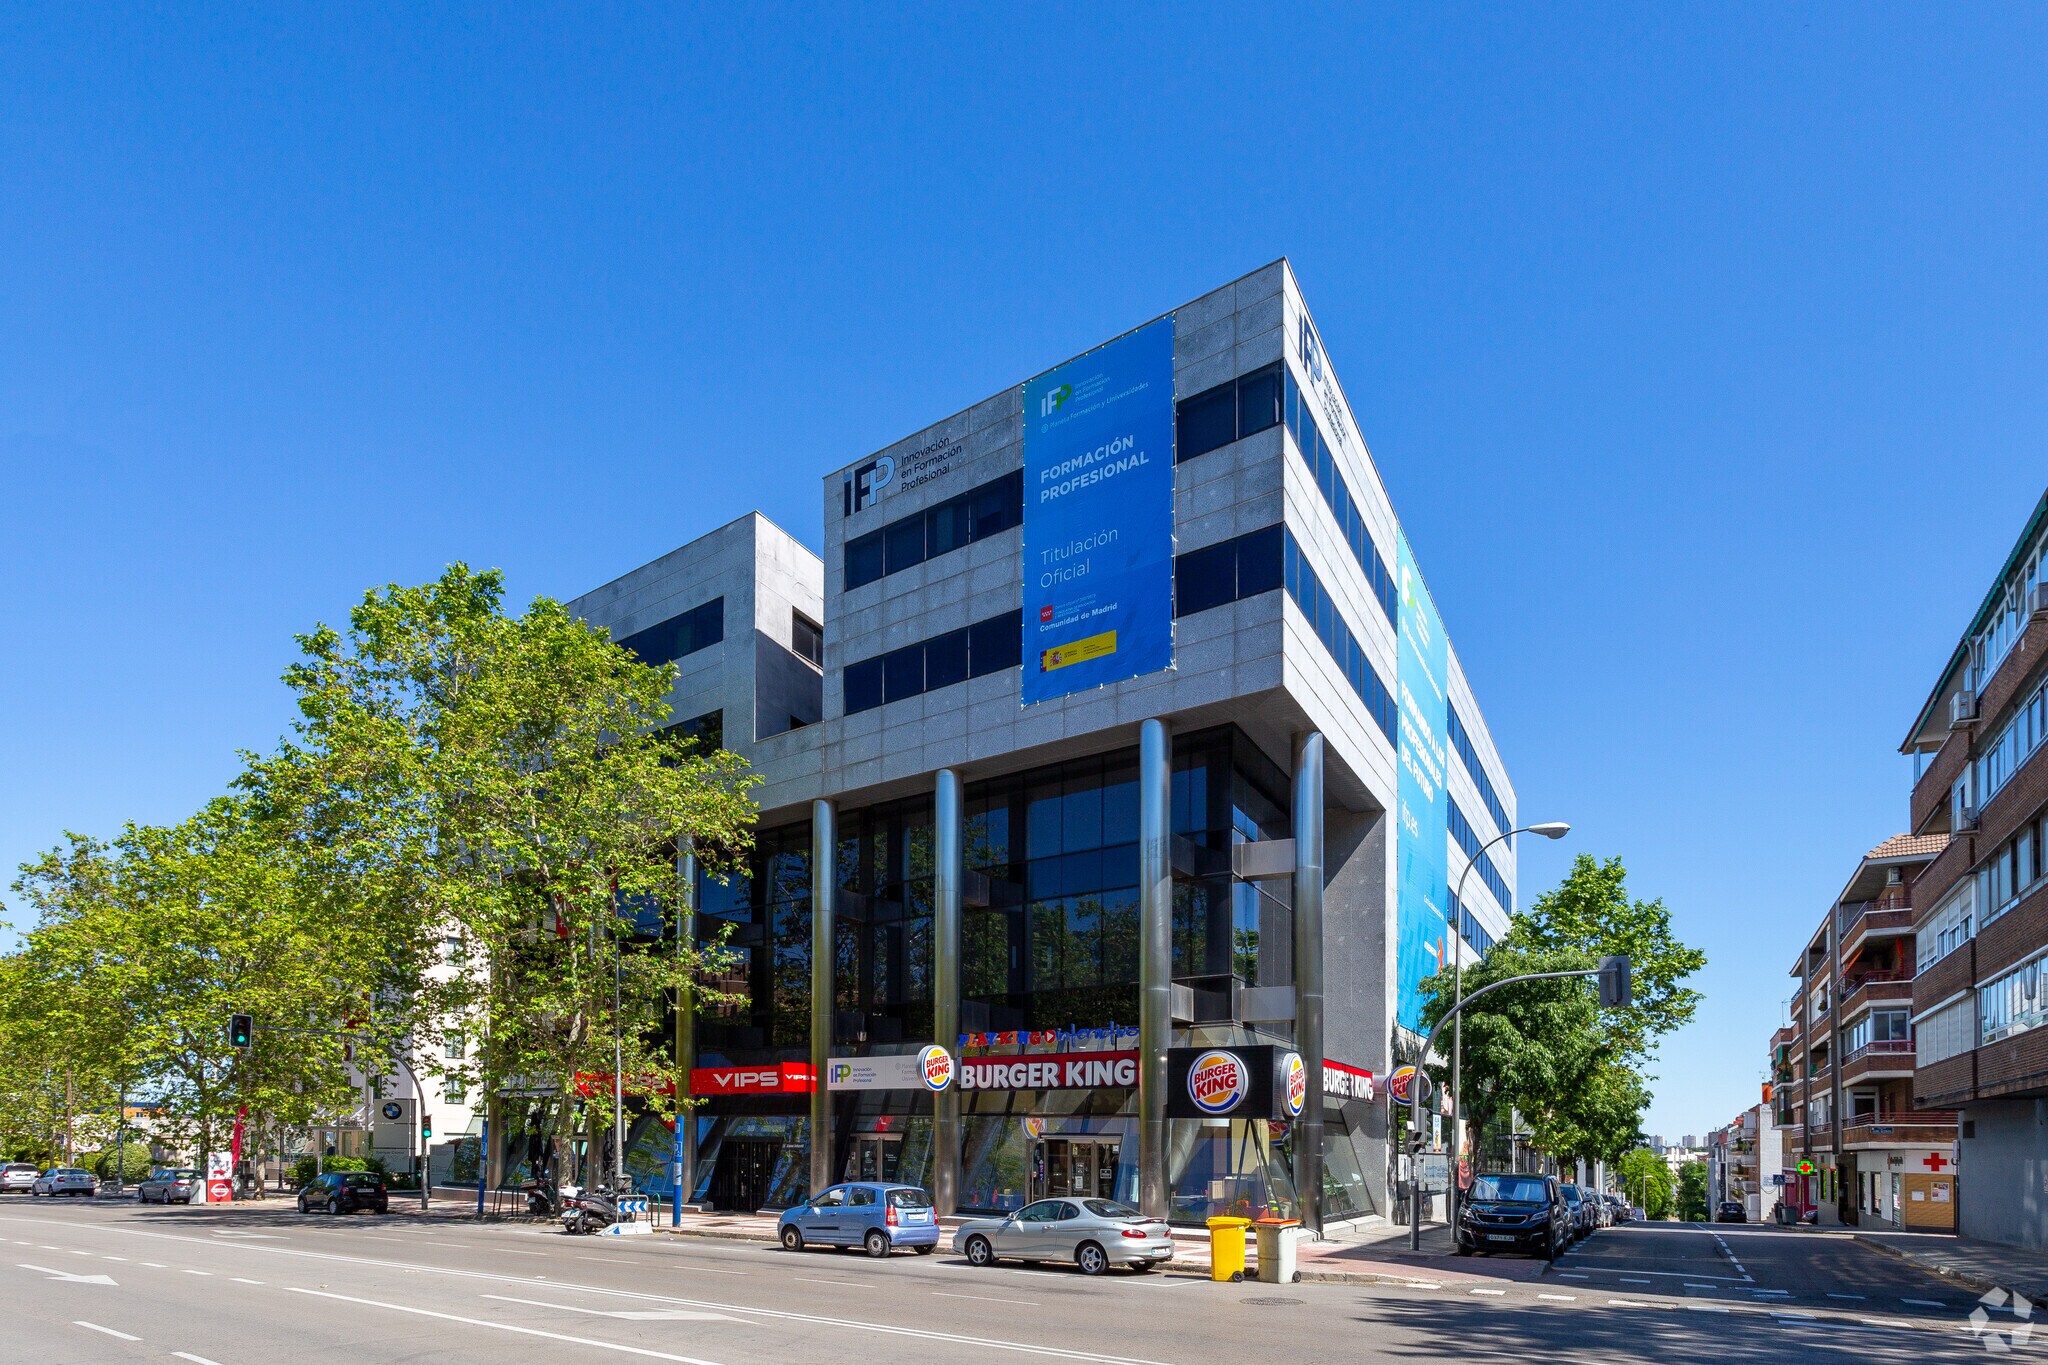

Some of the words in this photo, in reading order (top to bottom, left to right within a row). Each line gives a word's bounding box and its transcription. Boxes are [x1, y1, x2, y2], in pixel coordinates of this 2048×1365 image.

[1070, 402, 1101, 419] Formación
[1107, 381, 1149, 404] Universidades
[901, 437, 950, 465] Innovación
[901, 468, 912, 479] en
[914, 444, 962, 473] Formación
[1040, 434, 1134, 484] FORMACIÓN
[901, 463, 950, 492] Profesional
[1040, 451, 1150, 503] PROFESIONAL
[1040, 528, 1119, 565] Titulación
[1040, 558, 1090, 588] Oficial
[1040, 615, 1079, 632] Comunidad
[1080, 612, 1090, 620] de
[1091, 602, 1118, 616] Madrid
[925, 1055, 949, 1069] BURGER
[926, 1062, 950, 1080] KING
[960, 1062, 1060, 1089] BURGER
[1066, 1058, 1136, 1087] KING
[1194, 1063, 1236, 1084] BURGER
[1290, 1067, 1304, 1086] BURGER
[713, 1071, 779, 1088] VIPS
[1196, 1073, 1238, 1100] KING
[1290, 1079, 1305, 1101] KING
[1323, 1066, 1354, 1097] BURGER
[1354, 1074, 1374, 1101] KING
